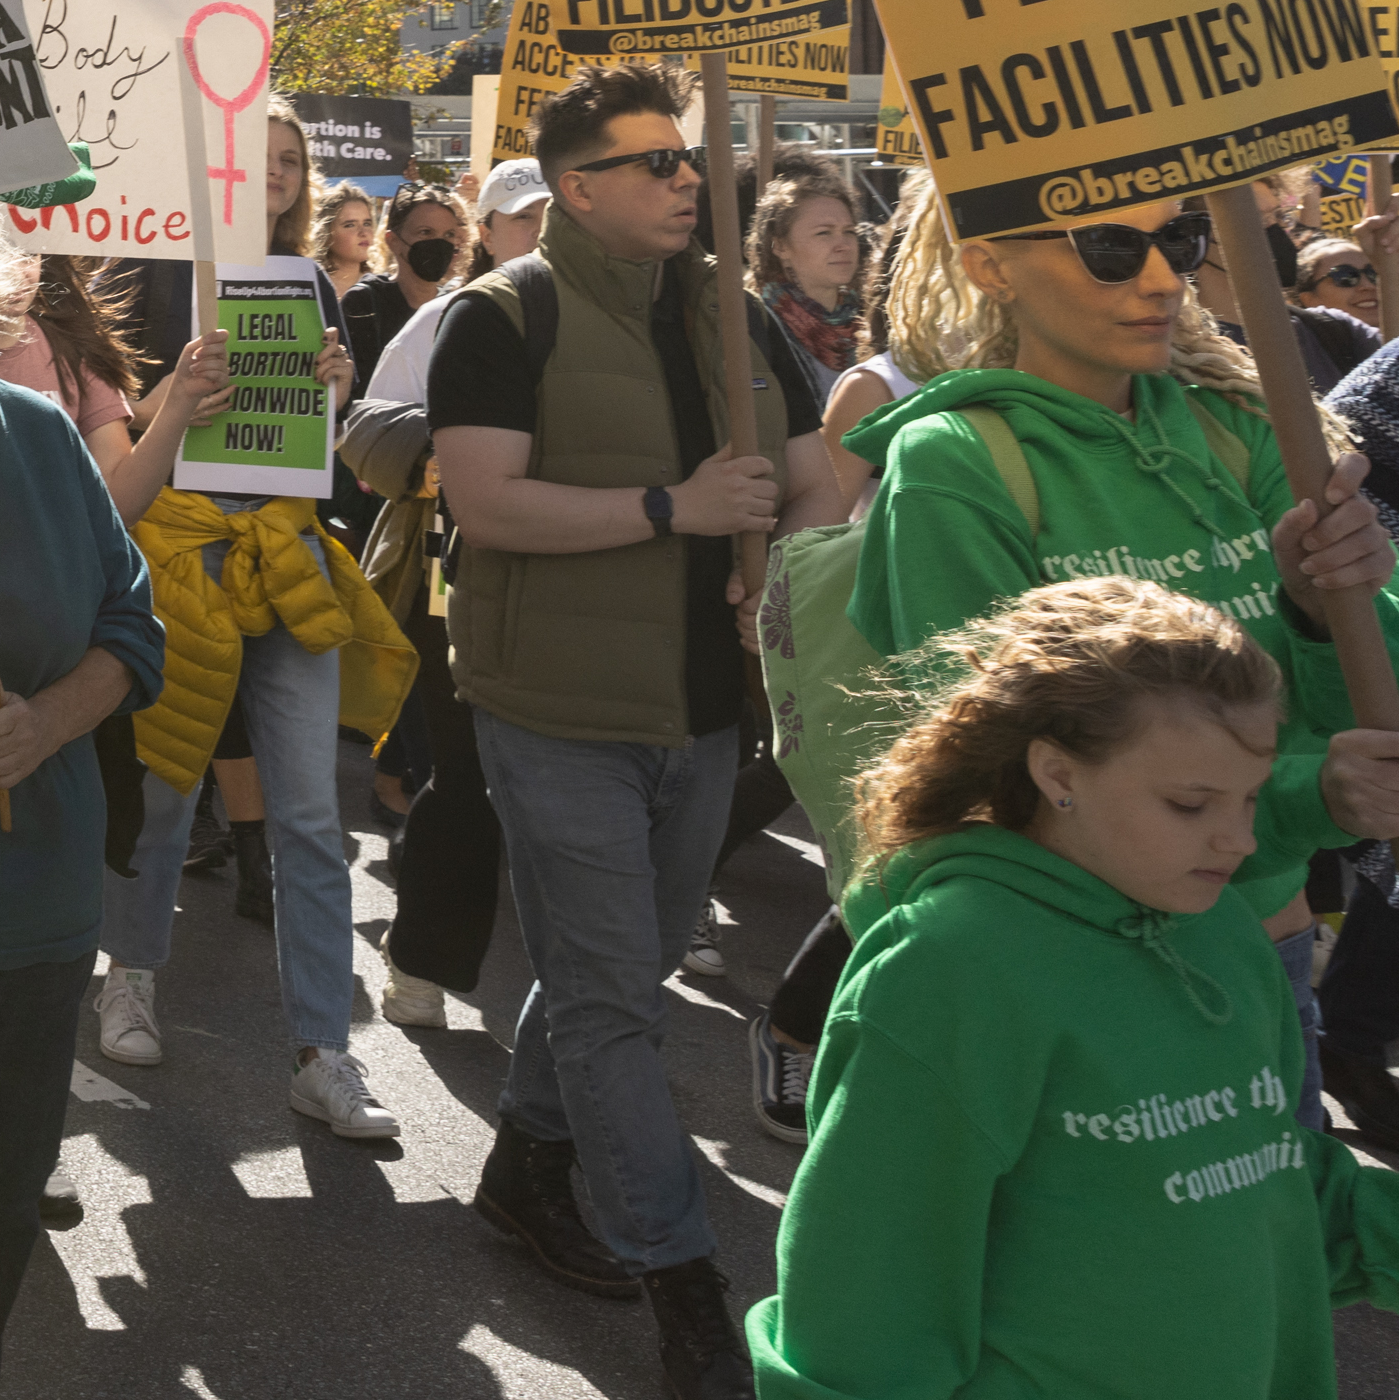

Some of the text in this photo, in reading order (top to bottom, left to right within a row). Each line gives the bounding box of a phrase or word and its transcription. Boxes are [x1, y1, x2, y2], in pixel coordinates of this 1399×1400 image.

[608, 8, 822, 55] @breakchainsmag
[803, 42, 849, 74] NOW
[727, 79, 829, 98] breakchainsmag
[909, 1, 1264, 160] FACILITIES
[301, 118, 383, 139] ortion is
[339, 141, 393, 161] Care.
[1037, 110, 1353, 219] @breakchainsmag
[237, 312, 298, 343] LEGAL
[228, 351, 315, 379] BORTION
[224, 423, 285, 454] NOW!
[1063, 1082, 1239, 1143] resilience
